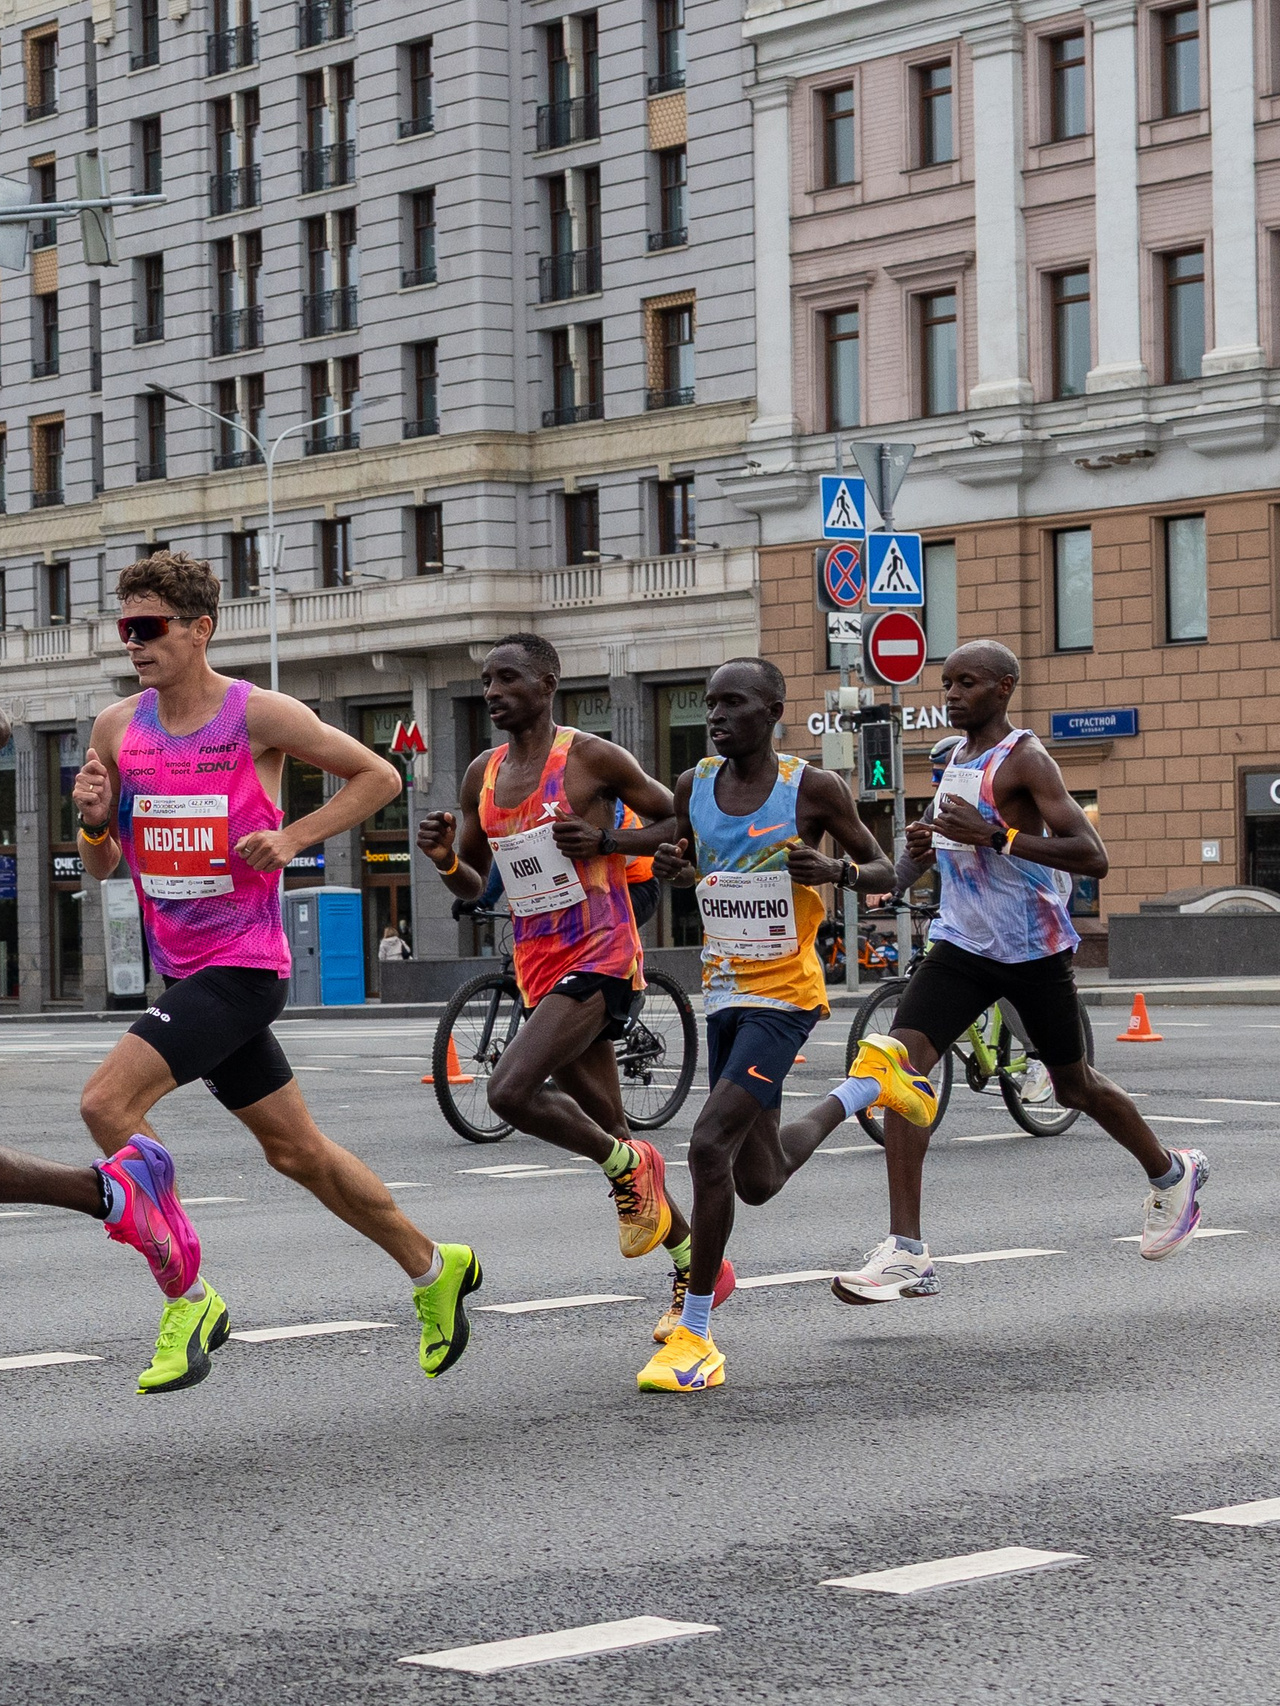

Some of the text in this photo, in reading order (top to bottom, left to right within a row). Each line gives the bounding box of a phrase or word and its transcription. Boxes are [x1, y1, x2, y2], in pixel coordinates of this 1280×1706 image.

[1069, 714, 1116, 728] СТРАСТНОЙ
[199, 742, 239, 754] FONBET
[143, 827, 214, 852] NEDELIN
[1203, 847, 1216, 858] GJ
[173, 861, 179, 870] 1
[509, 856, 543, 879] KIBII
[531, 883, 537, 891] 7
[702, 898, 789, 919] CHEMWENO
[742, 928, 748, 936] 4
